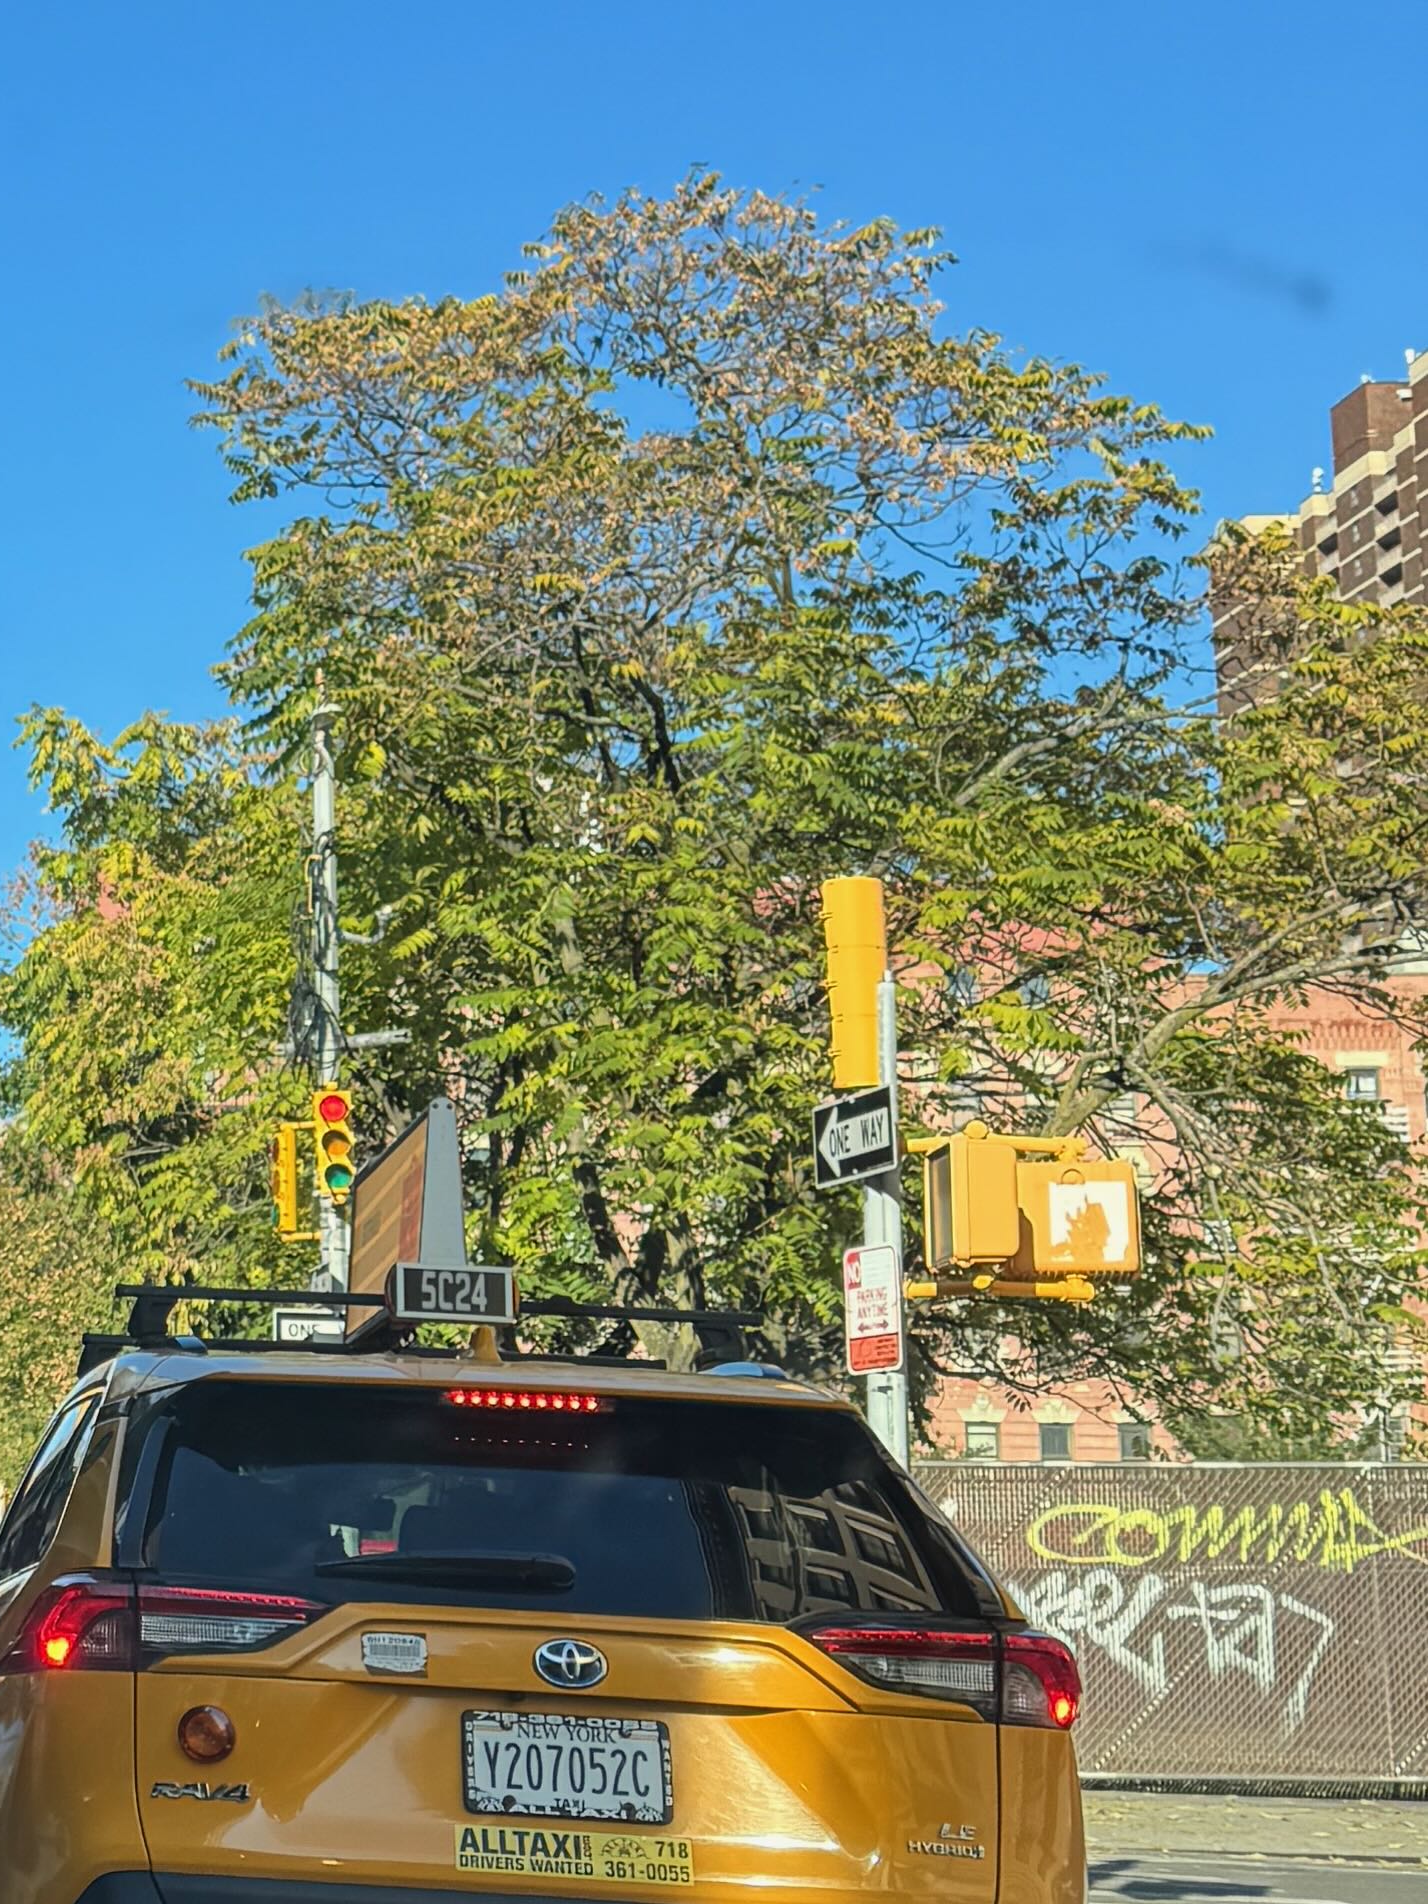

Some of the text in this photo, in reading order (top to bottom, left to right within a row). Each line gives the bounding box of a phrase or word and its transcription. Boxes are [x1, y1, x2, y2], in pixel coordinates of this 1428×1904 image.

[829, 1114, 883, 1157] ONE WAY
[847, 1260, 861, 1285] NO
[421, 1270, 488, 1313] 5C24
[516, 1724, 617, 1744] NEW YORK
[483, 1741, 651, 1798] Y207052C
[151, 1781, 251, 1804] RAV4
[940, 1823, 977, 1840] LE
[460, 1827, 581, 1861] ALLTAXI
[655, 1840, 689, 1859] 718
[907, 1840, 974, 1857] HYBRID
[459, 1855, 594, 1876] DRIVERS WANTED
[605, 1861, 690, 1883] 361-0055
